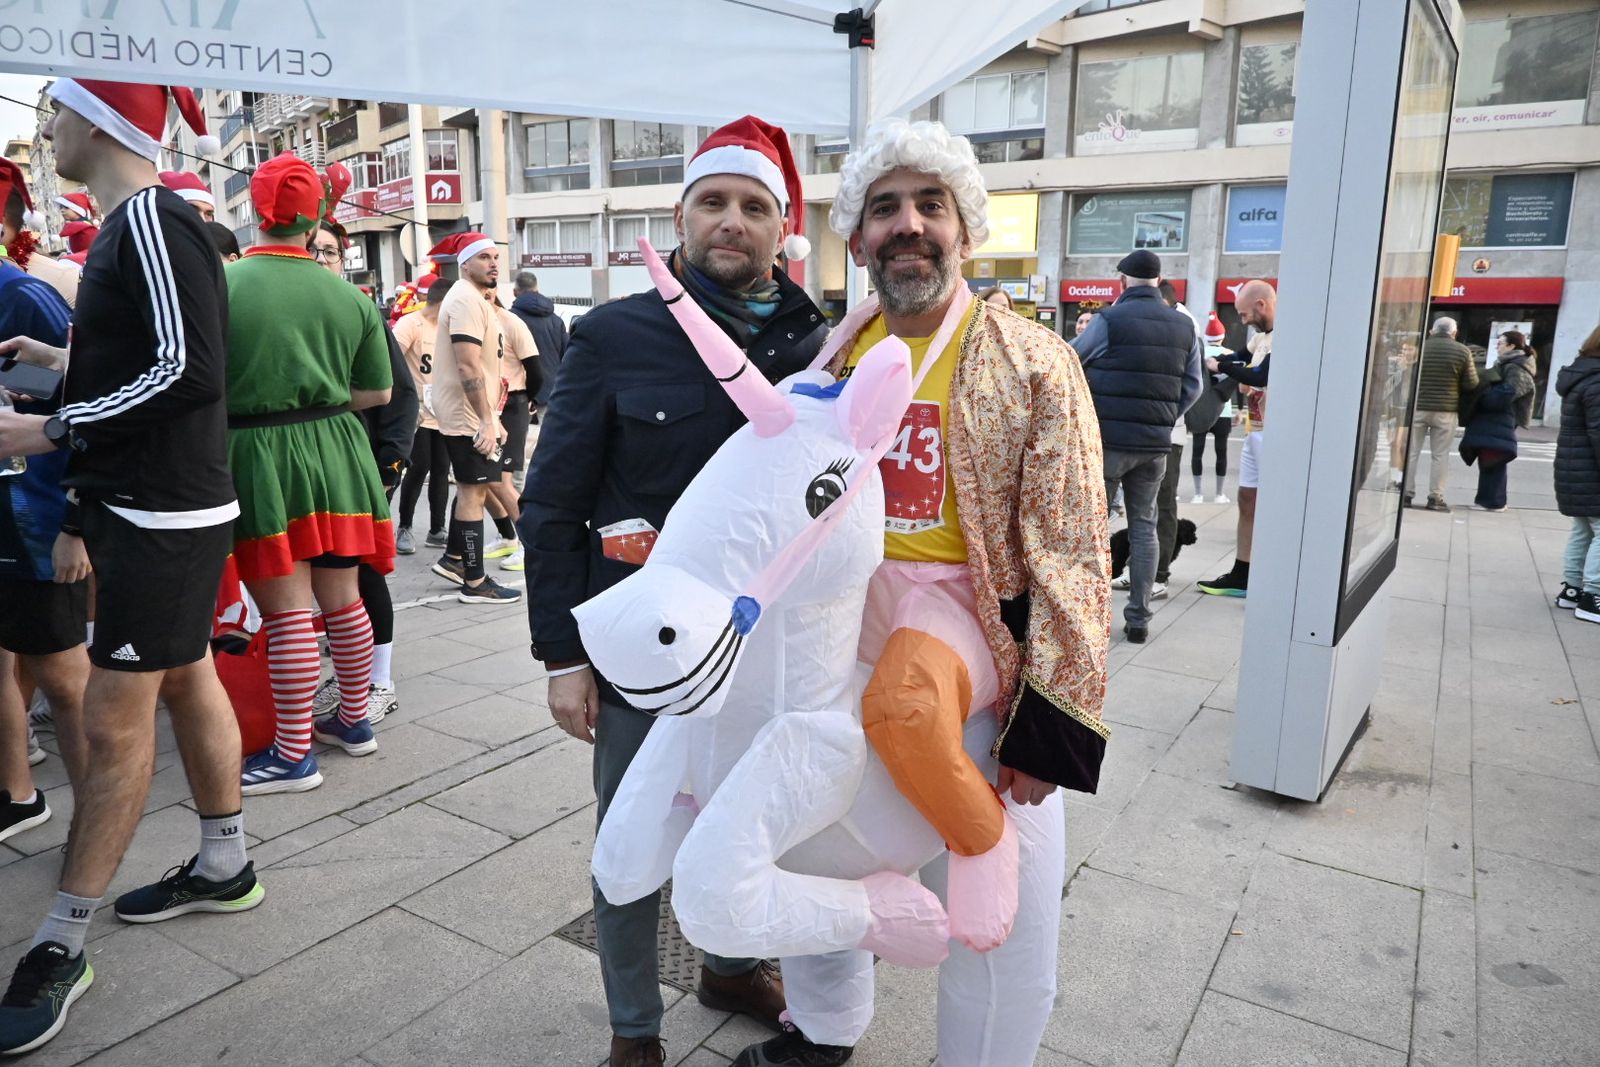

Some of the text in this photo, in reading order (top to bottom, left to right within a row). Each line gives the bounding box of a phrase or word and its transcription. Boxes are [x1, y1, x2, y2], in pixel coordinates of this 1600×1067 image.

[1239, 208, 1277, 222] alfa
[1068, 286, 1113, 296] Occident
[111, 653, 140, 661] adidas
